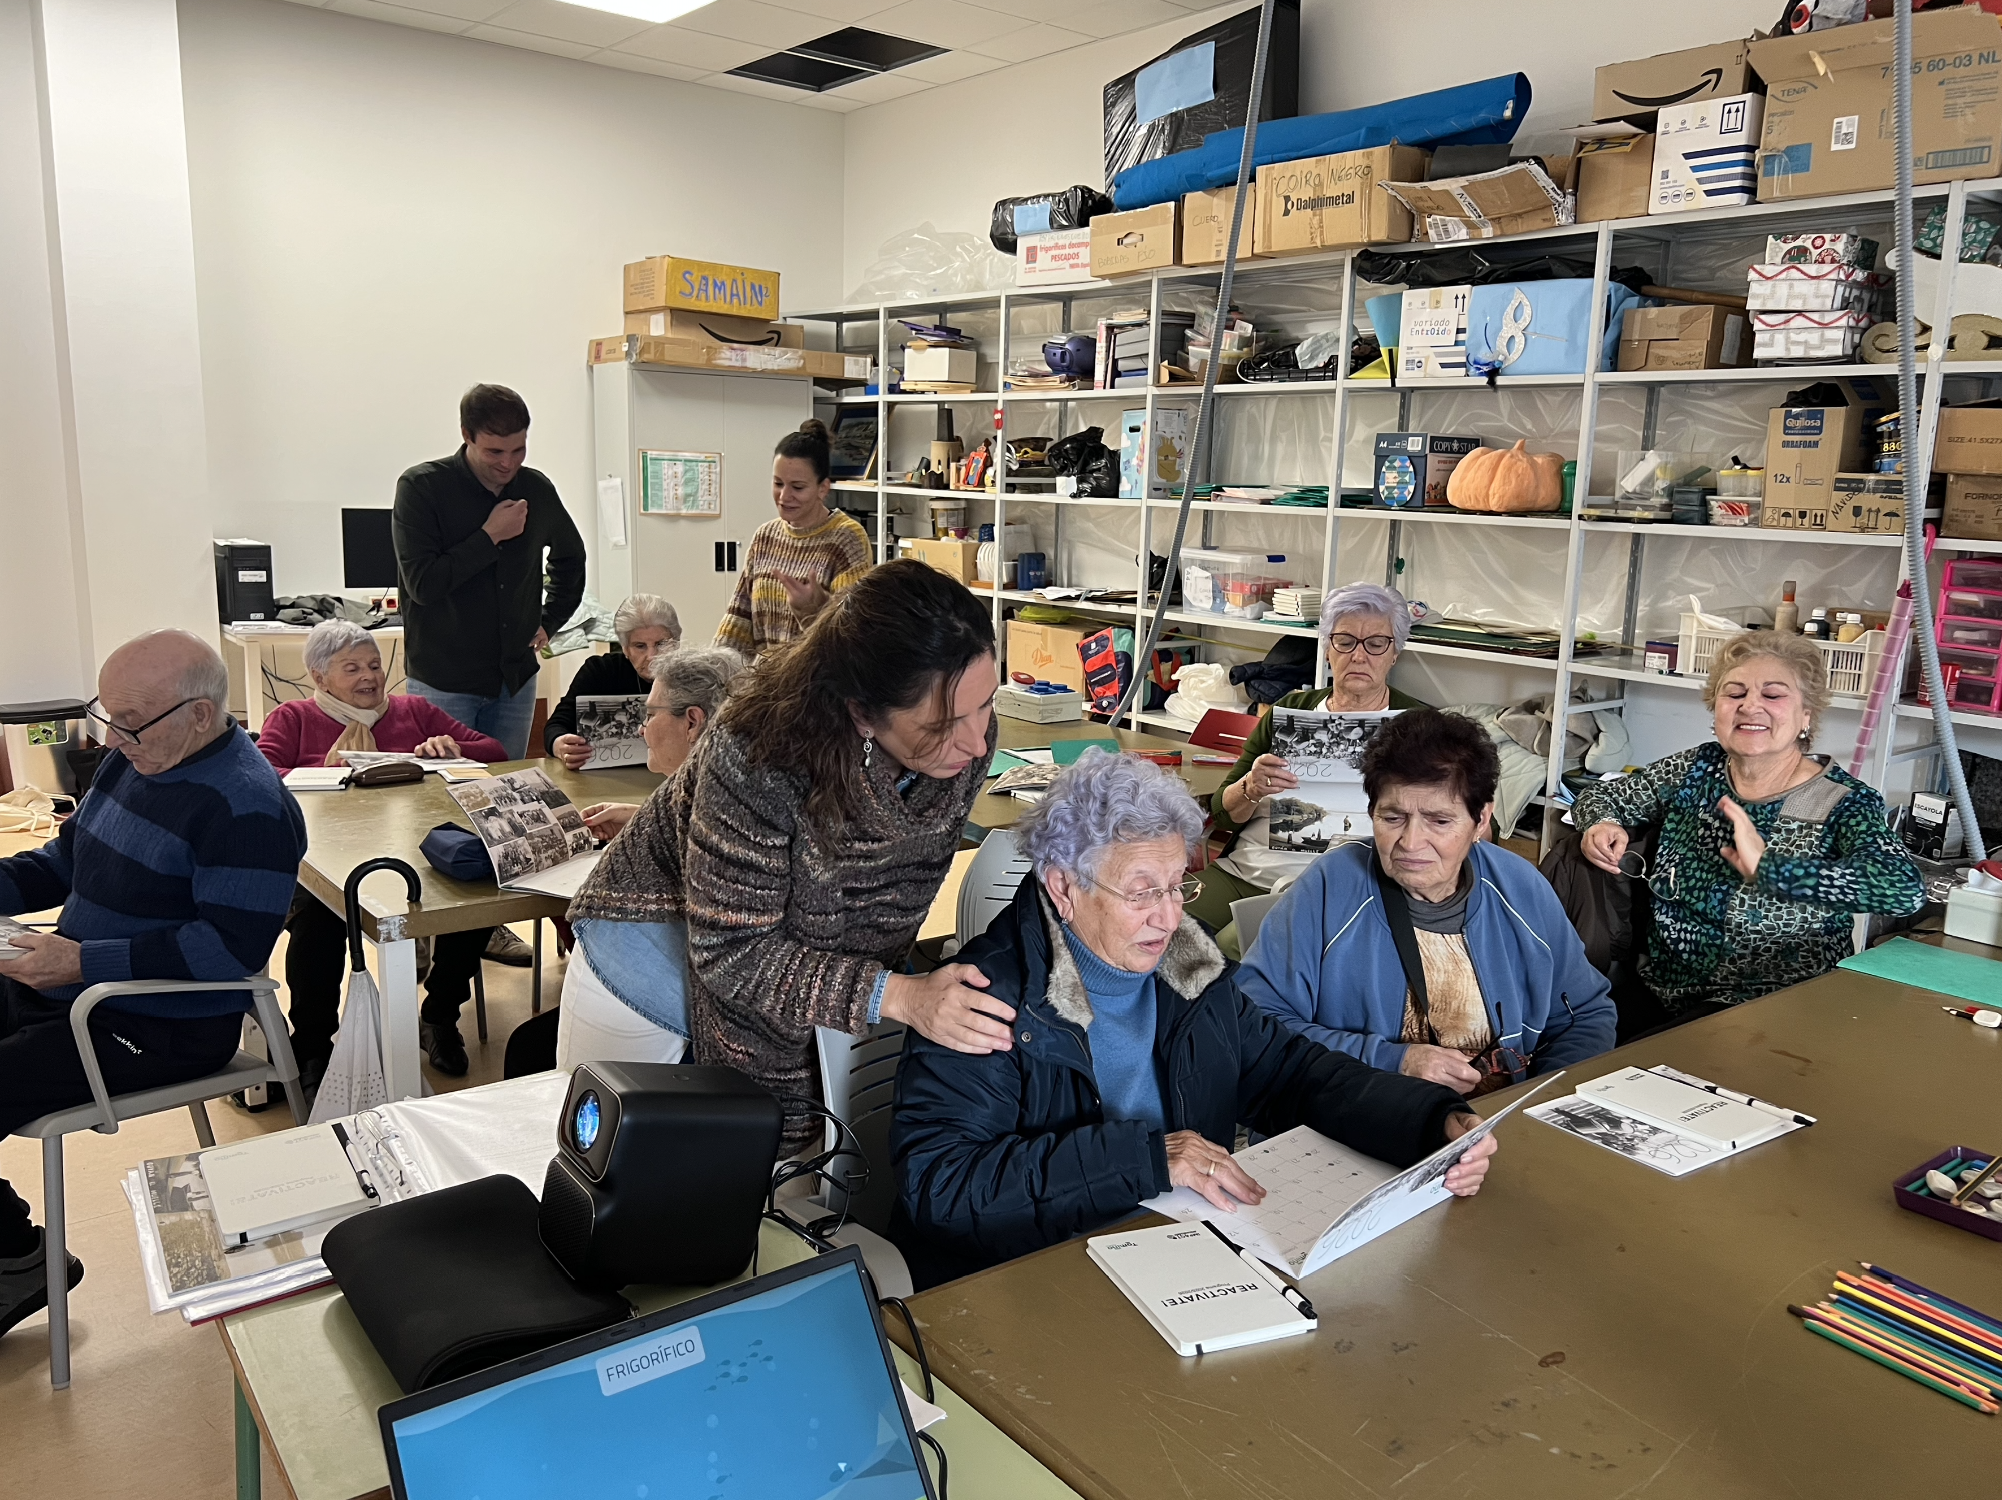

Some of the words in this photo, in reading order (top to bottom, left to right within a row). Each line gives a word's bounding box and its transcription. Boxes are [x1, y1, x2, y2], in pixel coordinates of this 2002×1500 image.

[1977, 50, 2000, 66] NL
[1781, 85, 1808, 98] TENA
[1275, 170, 1321, 198] COIRO
[1296, 191, 1355, 211] Dalphimetal
[1192, 214, 1219, 227] CUERO
[1051, 252, 1080, 263] PESCADOS
[1786, 418, 1821, 429] Quilosa
[1433, 441, 1451, 451] COPY
[1781, 440, 1820, 449] ORBAFOAM
[1773, 474, 1791, 484] 12x
[1289, 763, 1332, 778] 202
[1914, 803, 1943, 816] ESCAYOLA
[1160, 1282, 1259, 1308] REACTIVATE!
[606, 1339, 696, 1382] FRIGORÍFICO
